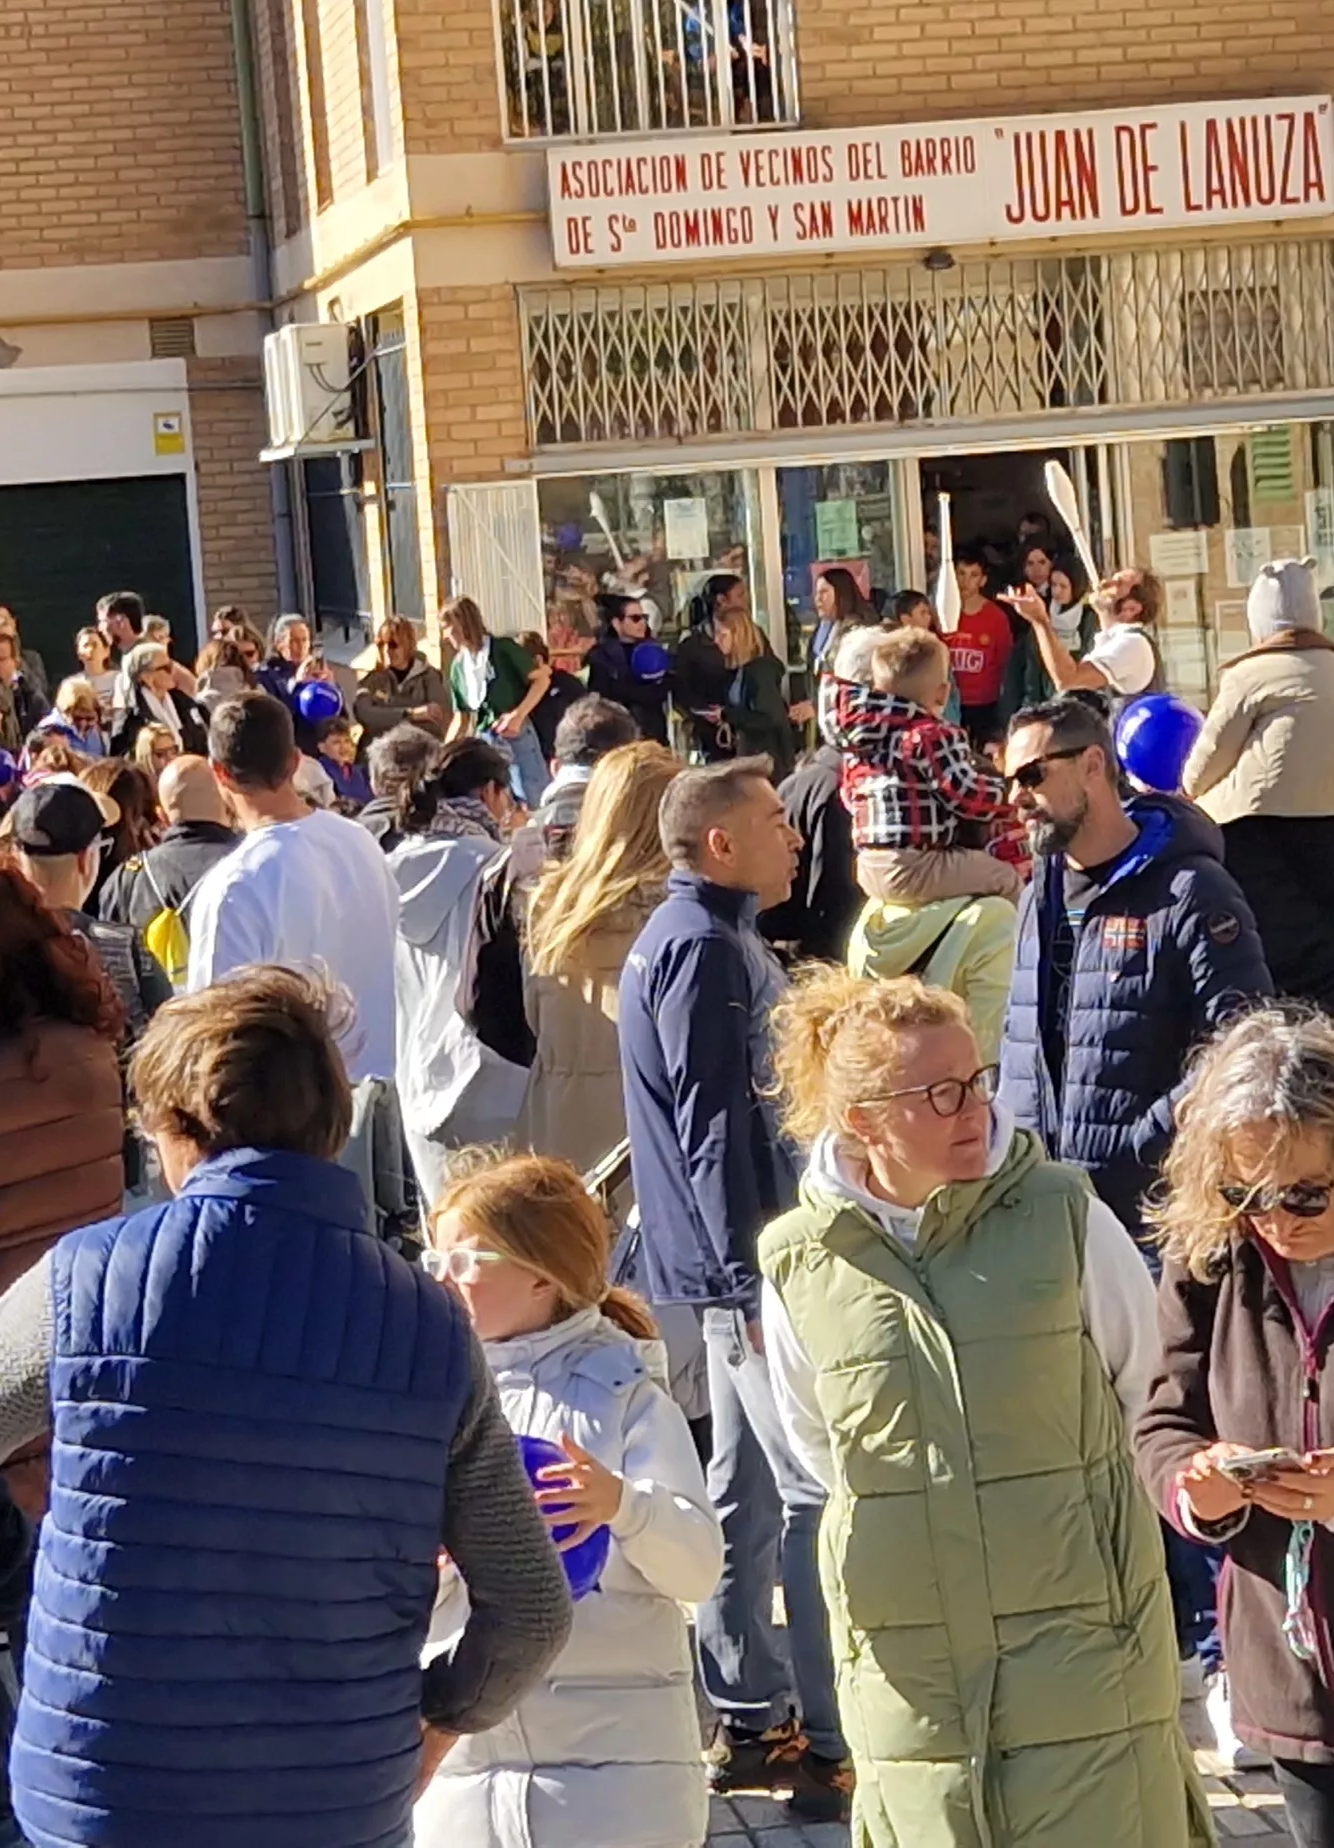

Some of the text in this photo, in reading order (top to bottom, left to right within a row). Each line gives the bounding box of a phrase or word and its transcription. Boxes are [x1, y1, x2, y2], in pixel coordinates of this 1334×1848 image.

[560, 135, 976, 200] ASOCIACION DE VECINOS DEL BARRIO
[1114, 121, 1164, 218] DE
[567, 215, 595, 255] DE
[654, 205, 754, 250] DOMINGO
[767, 203, 779, 243] Y
[793, 199, 834, 241] SAN
[847, 193, 926, 237] MARTIN
